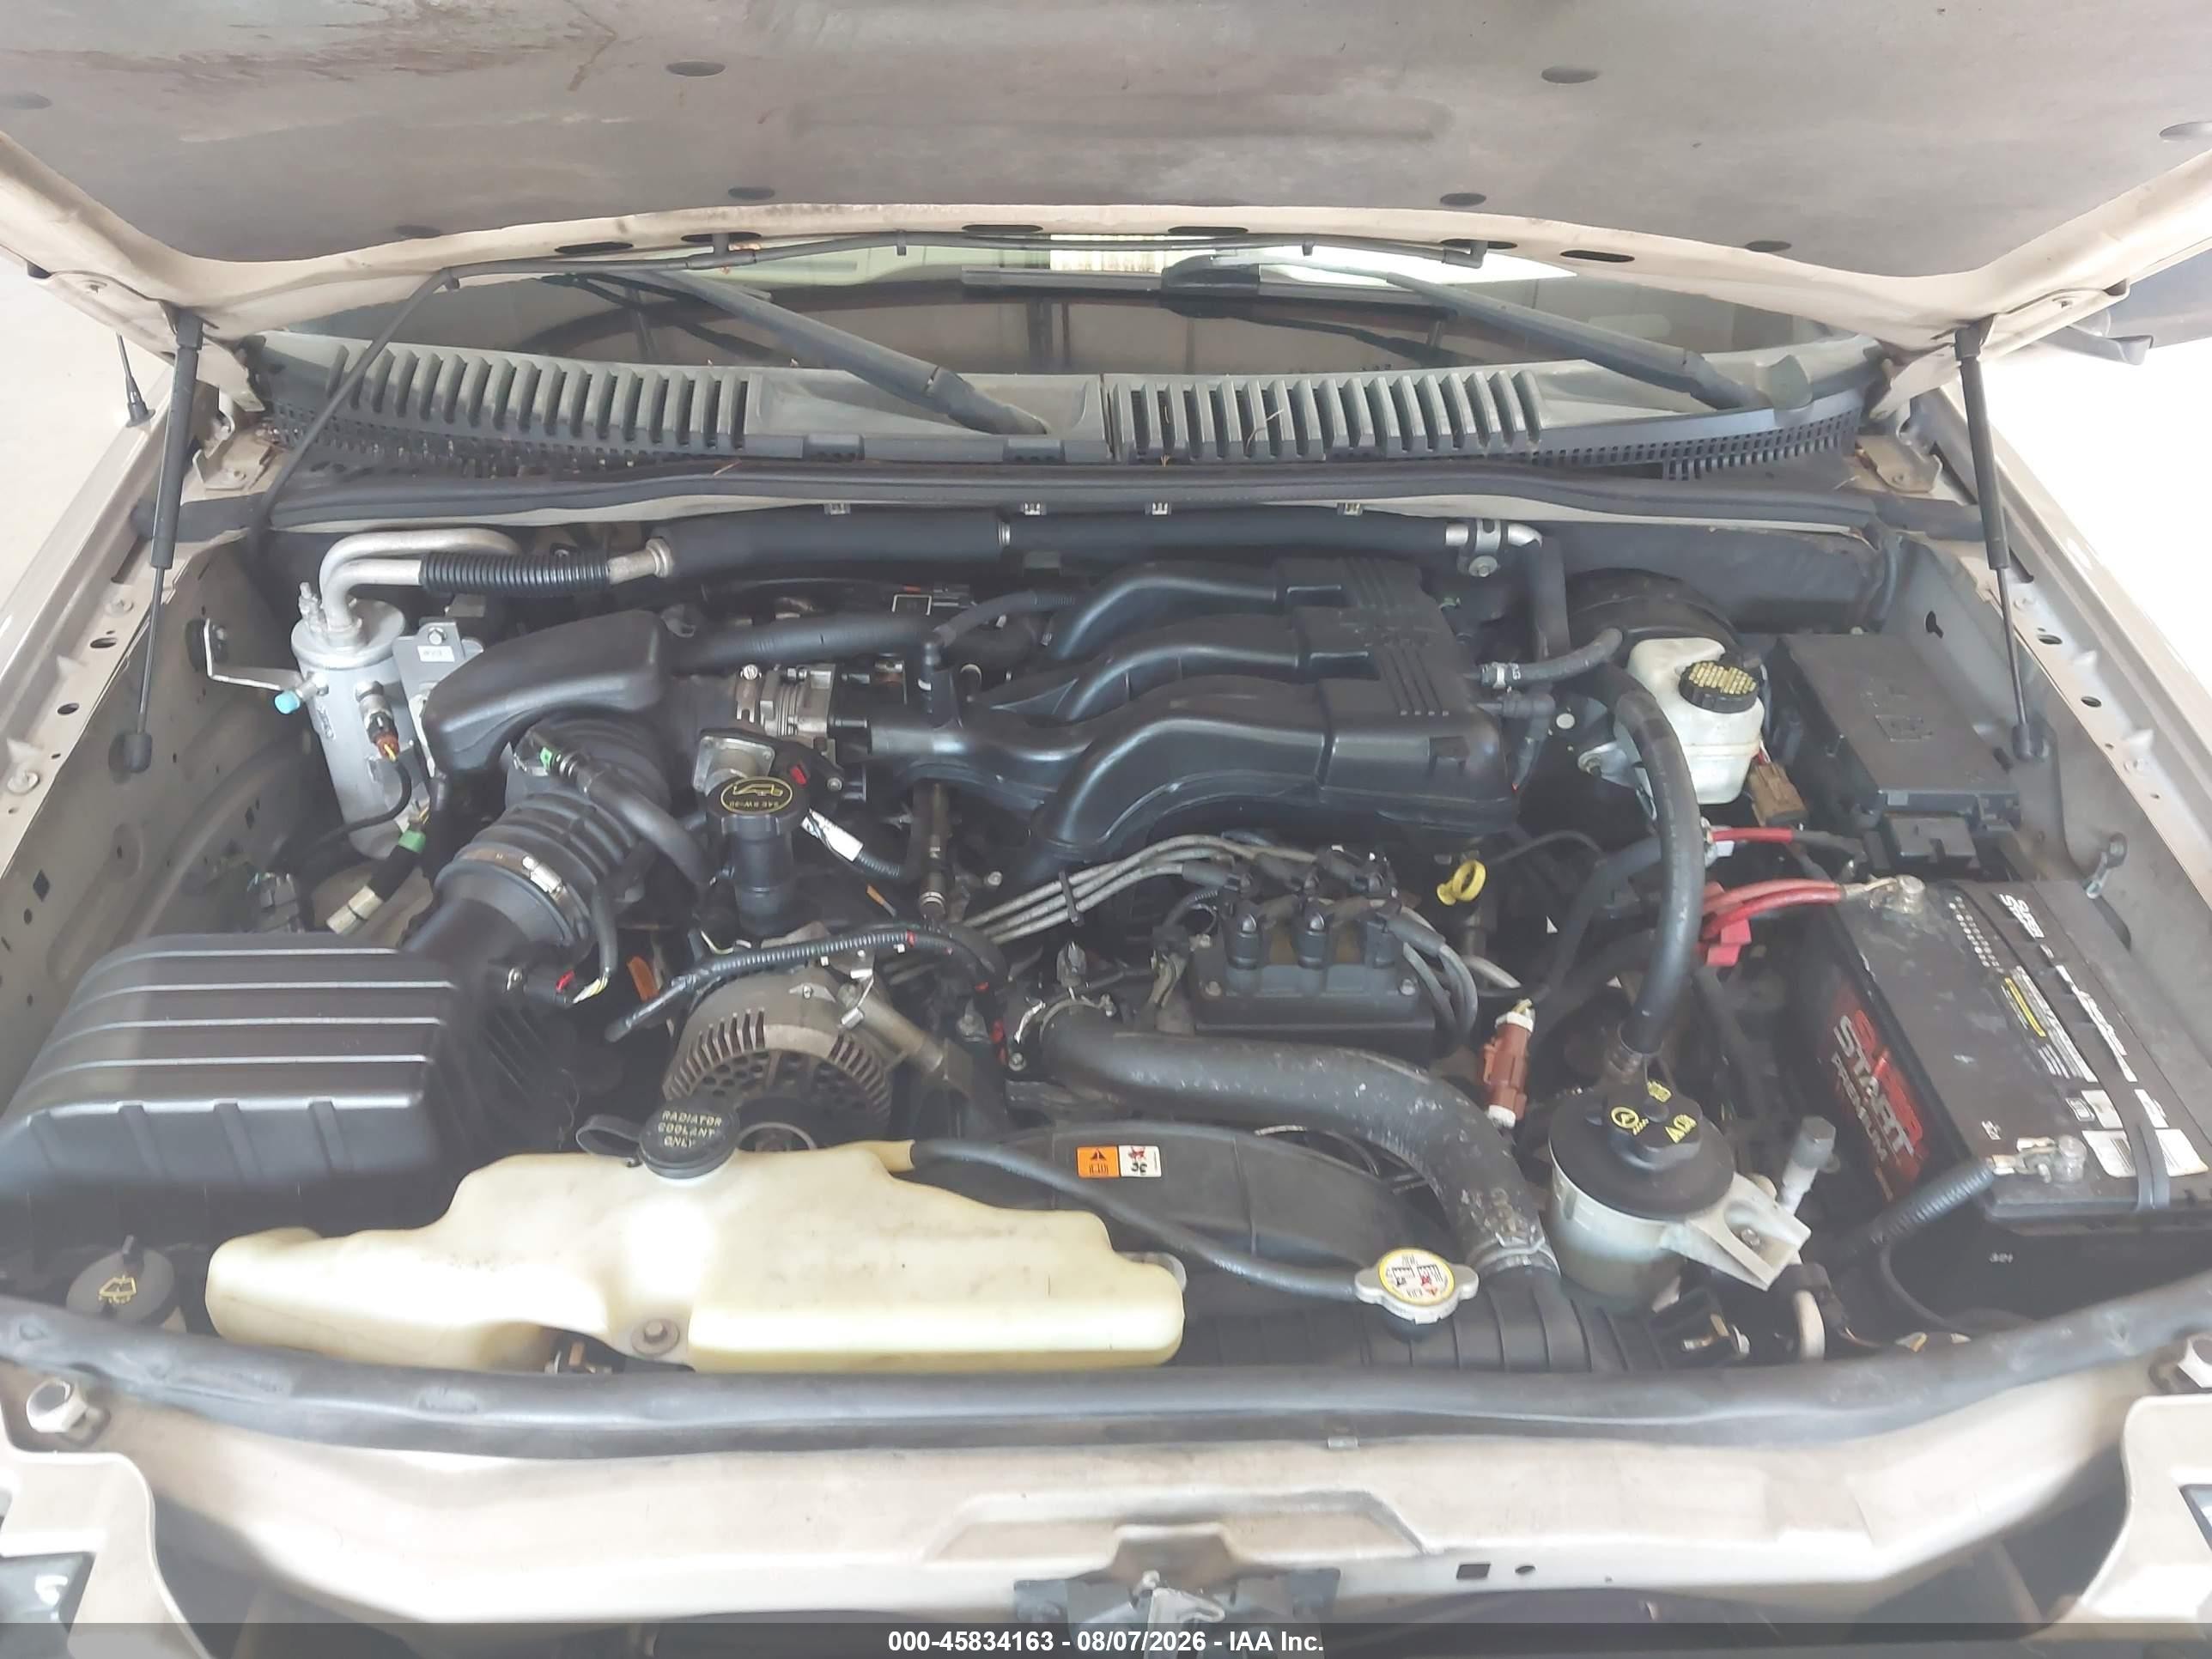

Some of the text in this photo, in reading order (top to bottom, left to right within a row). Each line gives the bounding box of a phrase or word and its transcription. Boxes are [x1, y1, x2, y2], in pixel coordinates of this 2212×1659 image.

[1830, 1050, 1888, 1162] PREMIUM
[1833, 1014, 1915, 1156] START
[658, 1121, 715, 1139] COOLANT
[662, 1110, 722, 1127] RADIATOR
